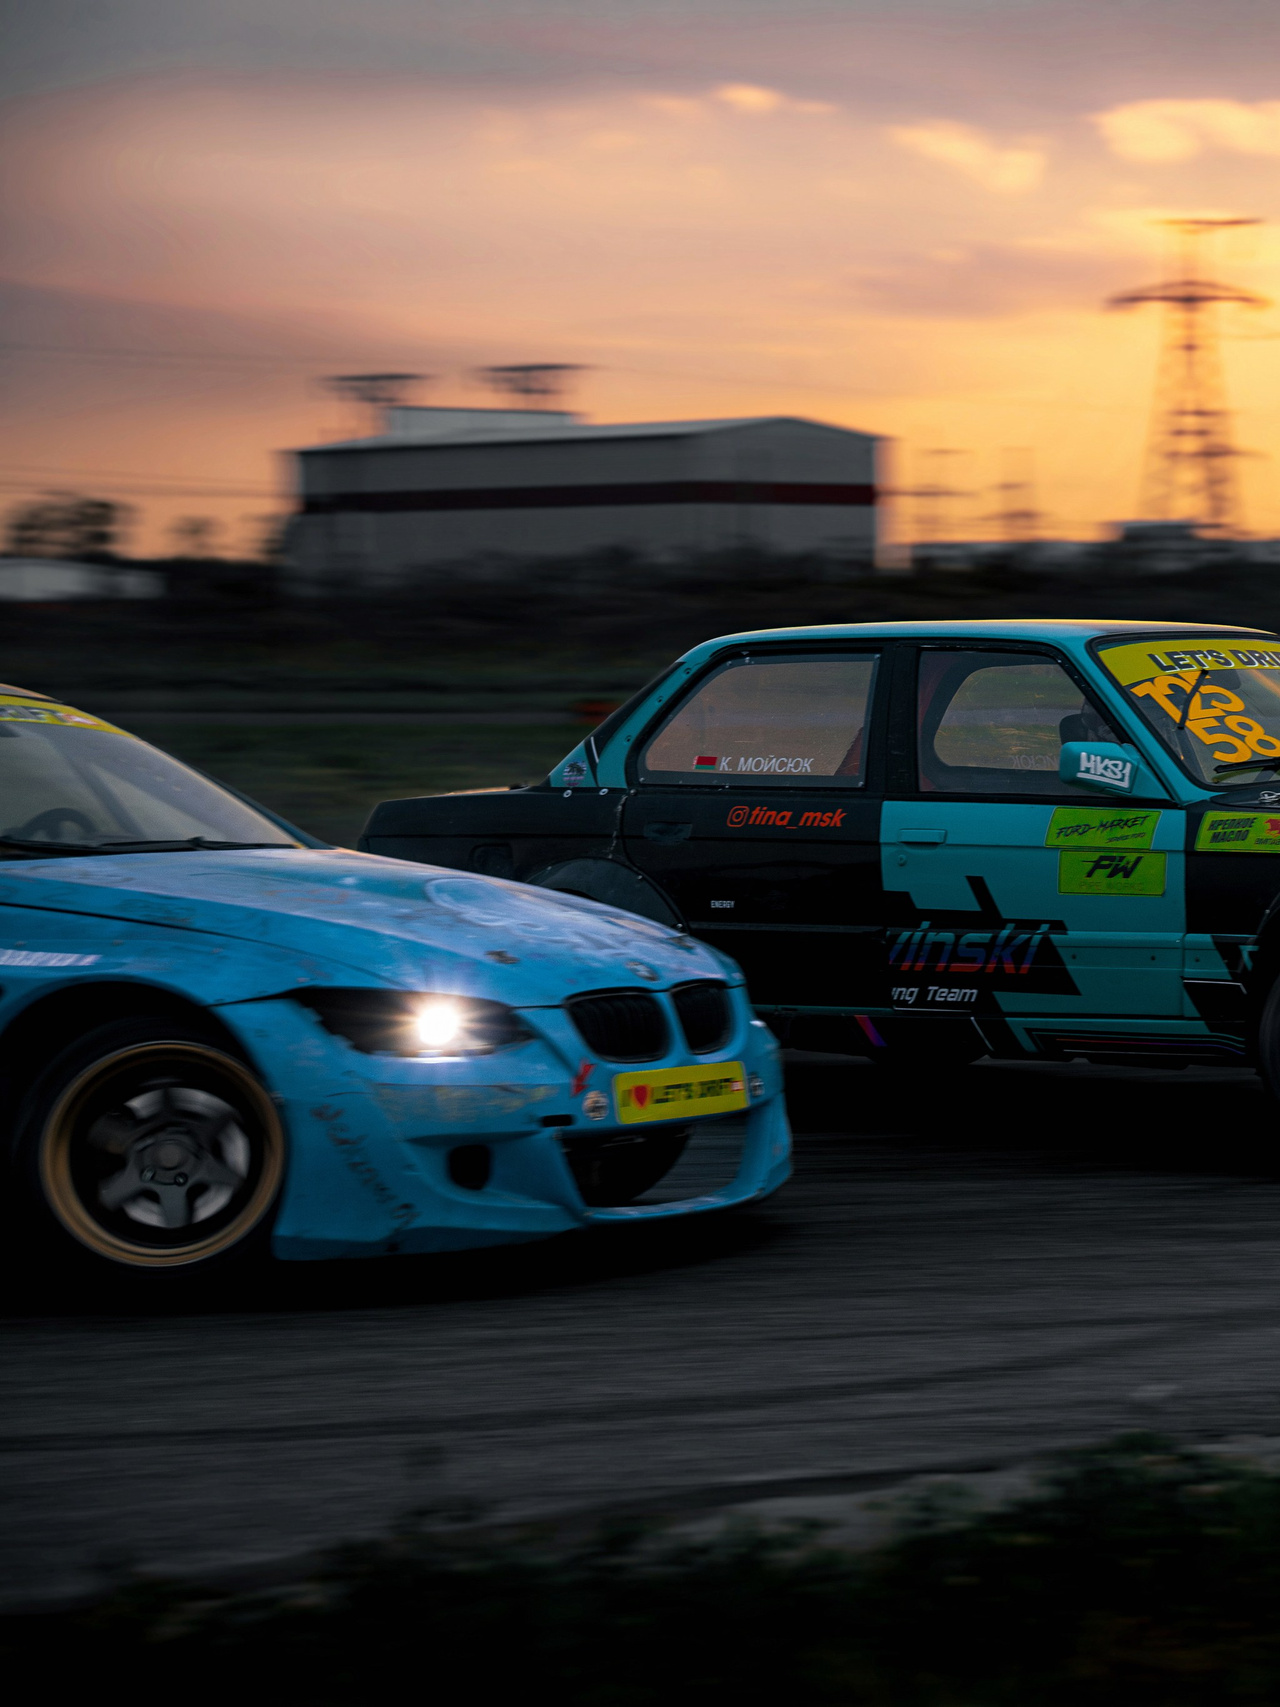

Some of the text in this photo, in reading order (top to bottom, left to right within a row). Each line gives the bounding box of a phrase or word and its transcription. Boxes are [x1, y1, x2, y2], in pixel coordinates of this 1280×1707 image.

[1147, 649, 1235, 672] LET'S
[719, 755, 814, 773] К. МОЙСЮК
[1207, 817, 1259, 831] КРЕПКОЕ
[1209, 830, 1250, 843] МАСЛО
[927, 986, 978, 1002] Team
